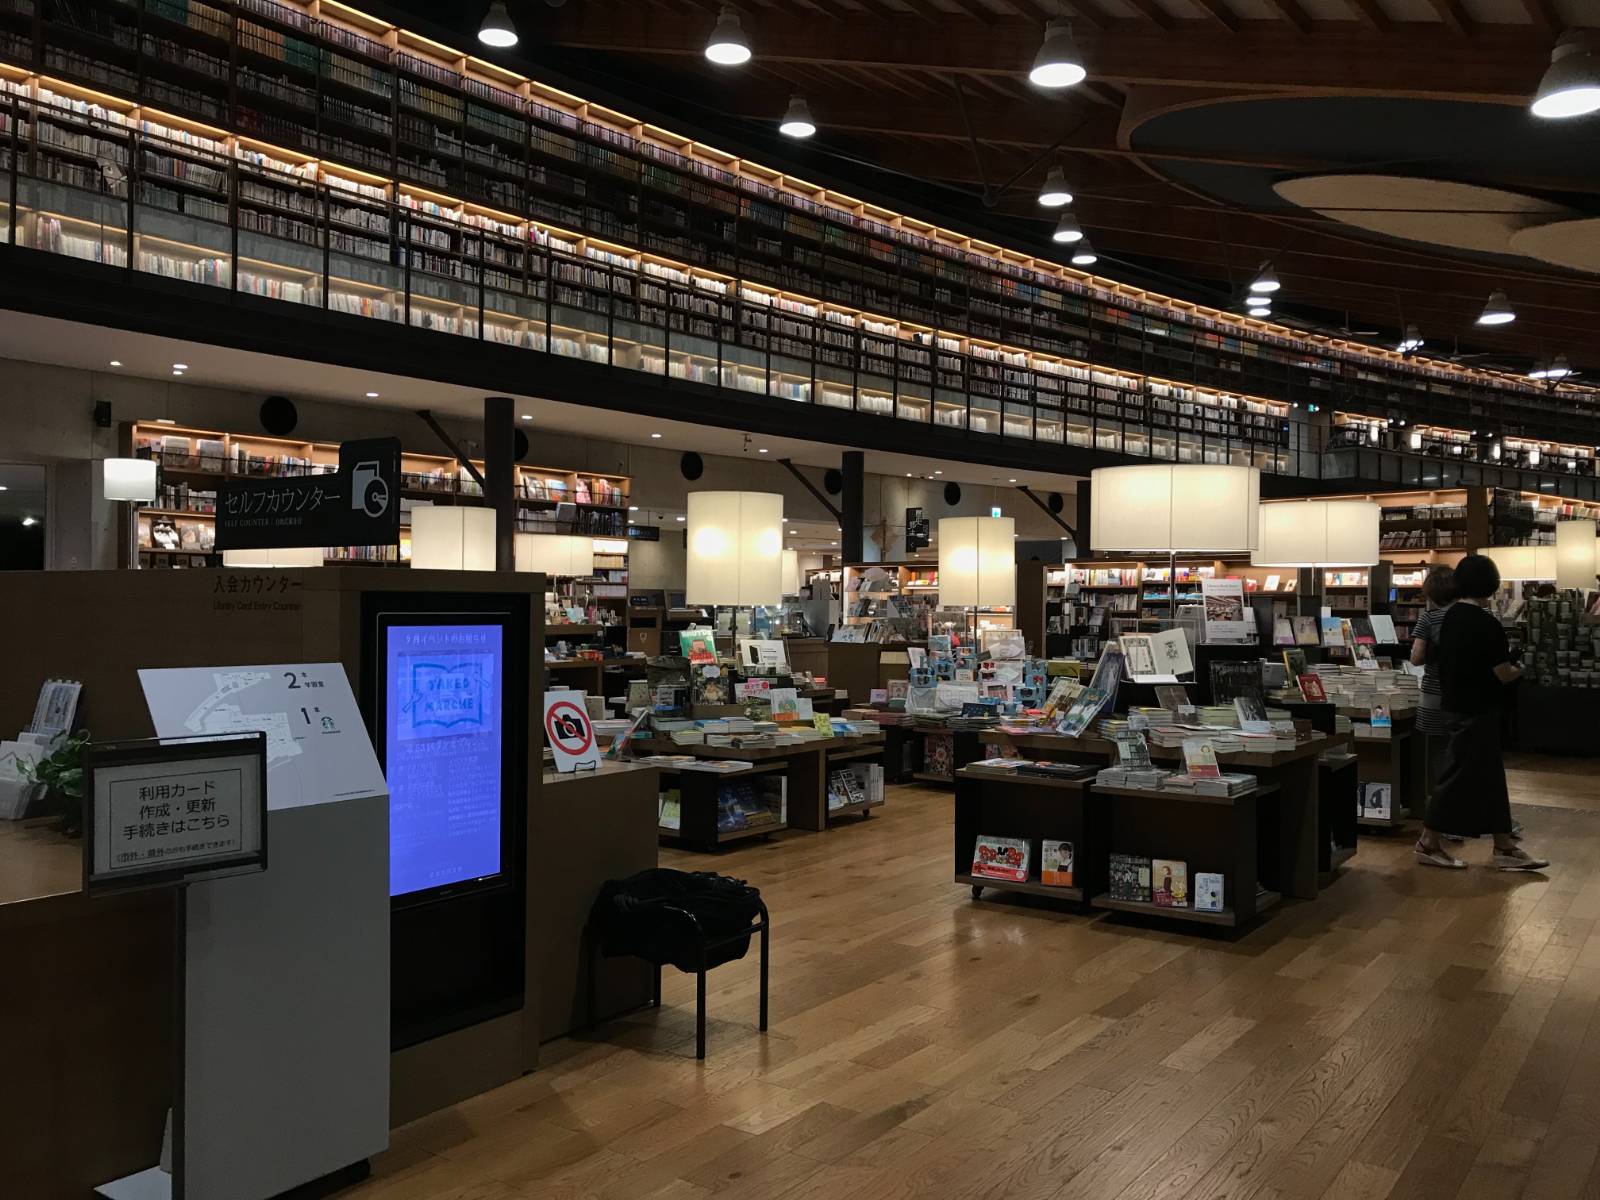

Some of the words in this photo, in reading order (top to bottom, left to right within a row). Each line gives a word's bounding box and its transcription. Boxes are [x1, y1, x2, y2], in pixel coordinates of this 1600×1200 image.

[225, 485, 341, 514] セルフカウンター
[213, 575, 303, 594] 入会カウンター
[284, 672, 301, 689] 2
[301, 707, 311, 725] 1
[139, 780, 216, 801] 利用カード
[139, 797, 216, 820] 作成・更新
[123, 814, 231, 841] 手続きはこちら
